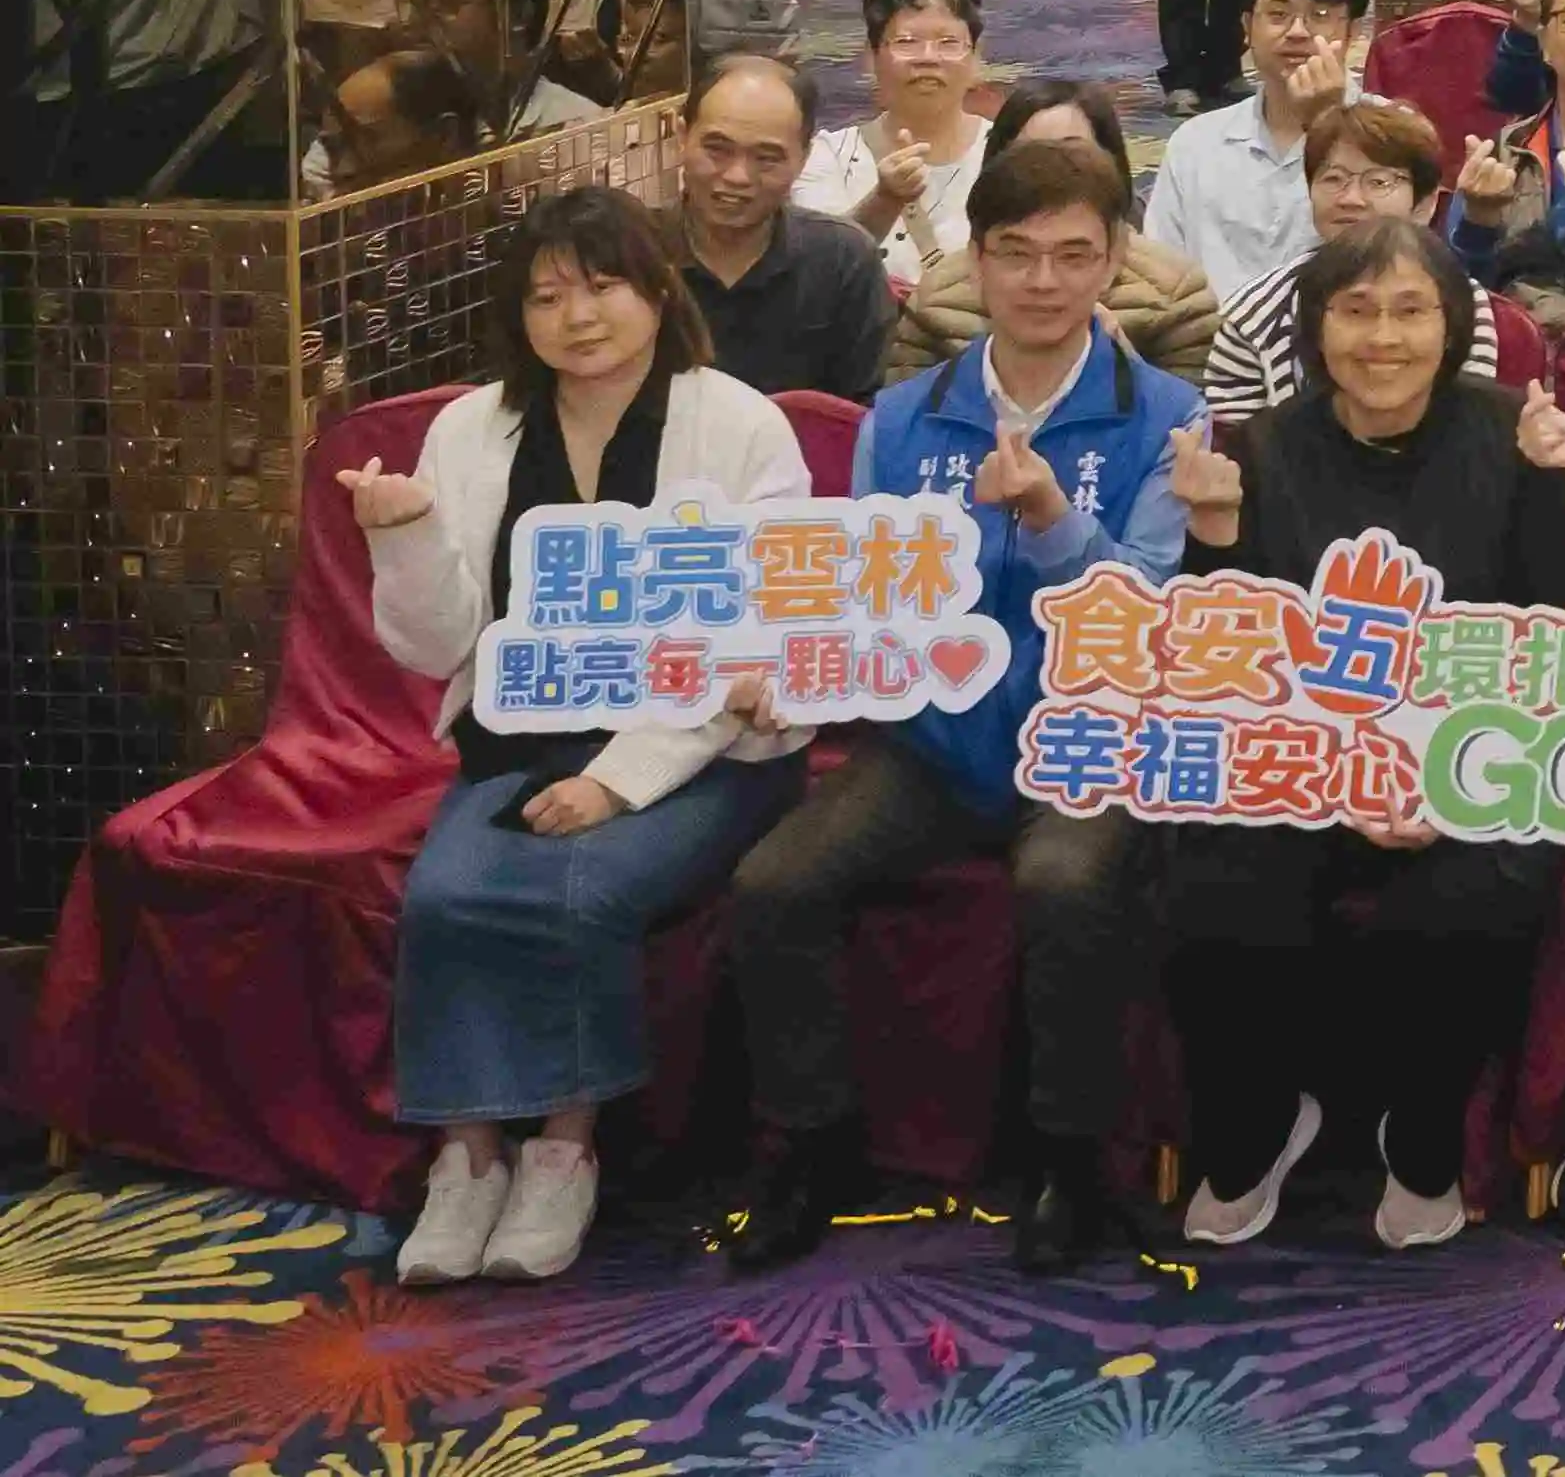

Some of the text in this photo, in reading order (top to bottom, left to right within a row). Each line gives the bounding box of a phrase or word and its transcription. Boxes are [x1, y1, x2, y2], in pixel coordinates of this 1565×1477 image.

[534, 512, 960, 626] 點亮雲林
[498, 632, 922, 710] 點亮每一顆心
